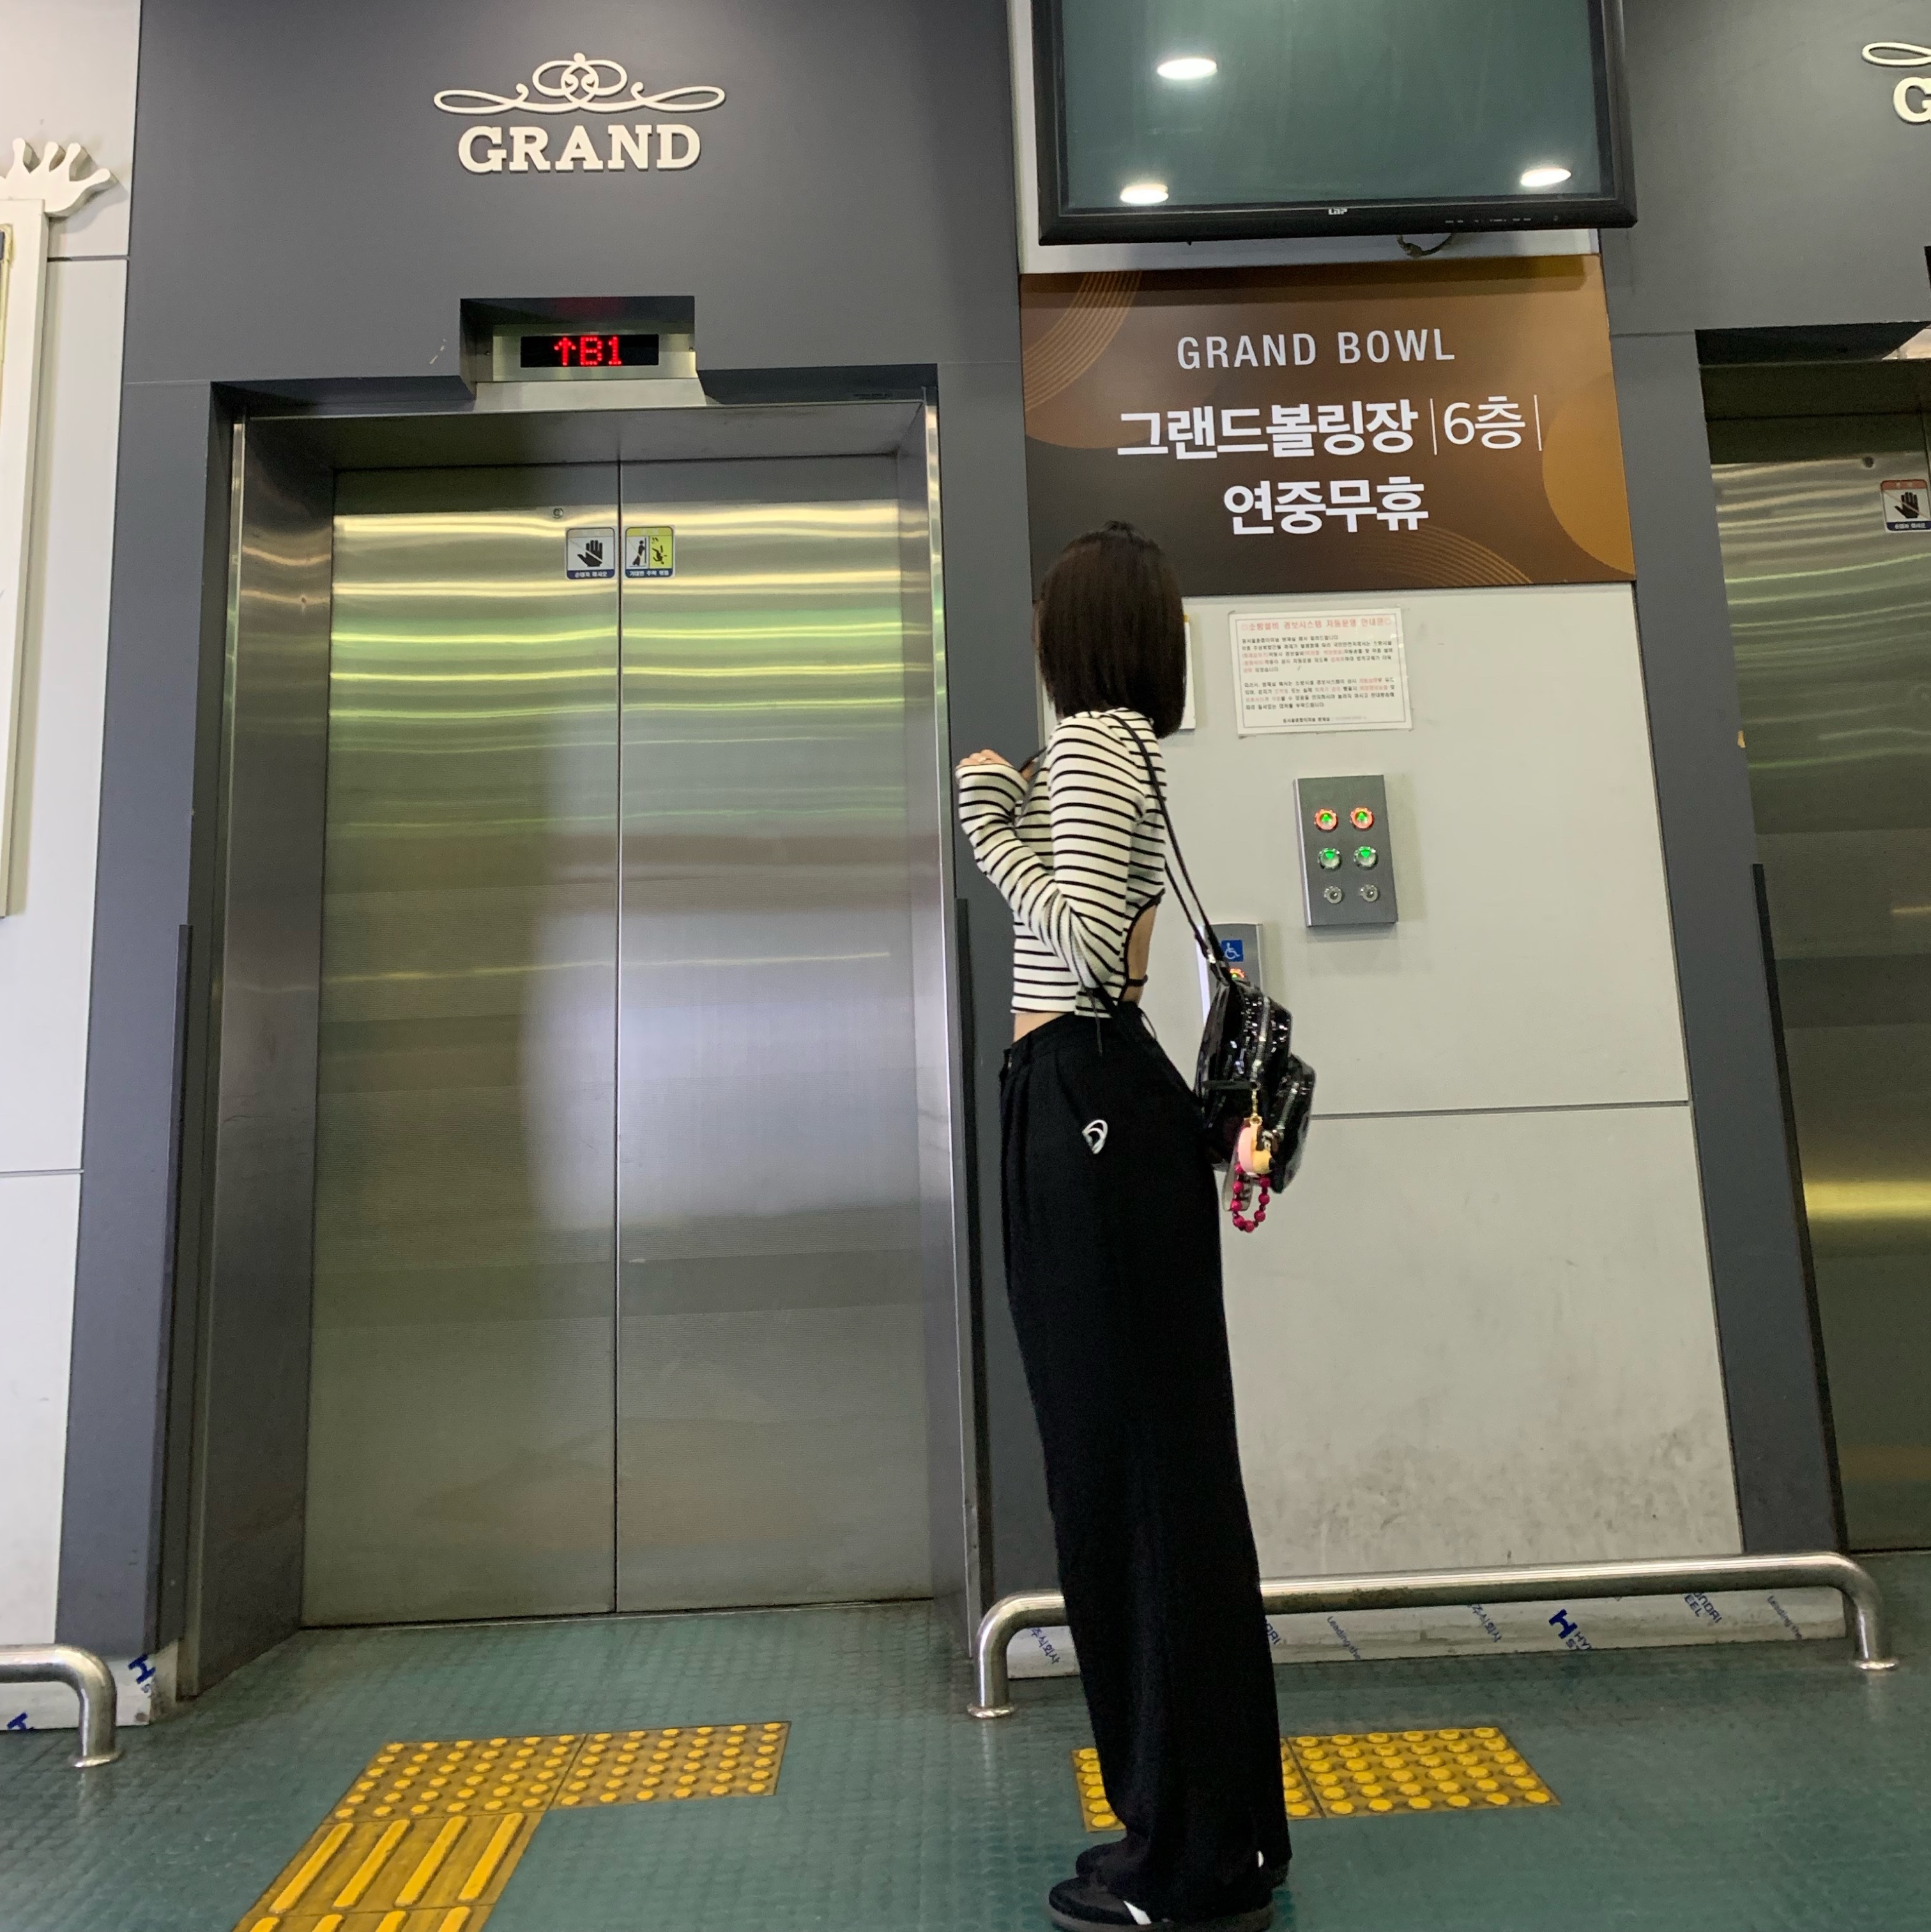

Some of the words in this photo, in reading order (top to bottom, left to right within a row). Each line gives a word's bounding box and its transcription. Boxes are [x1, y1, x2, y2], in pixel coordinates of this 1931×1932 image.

[458, 123, 701, 173] GRAND
[580, 335, 622, 366] B1
[1177, 333, 1316, 369] GRAND
[1338, 329, 1455, 364] BOWL
[1117, 399, 1418, 459] 그랜드볼링장
[1444, 395, 1526, 451] 6층
[1224, 476, 1429, 535] 연중무휴
[1030, 1627, 1061, 1664] 주식회사
